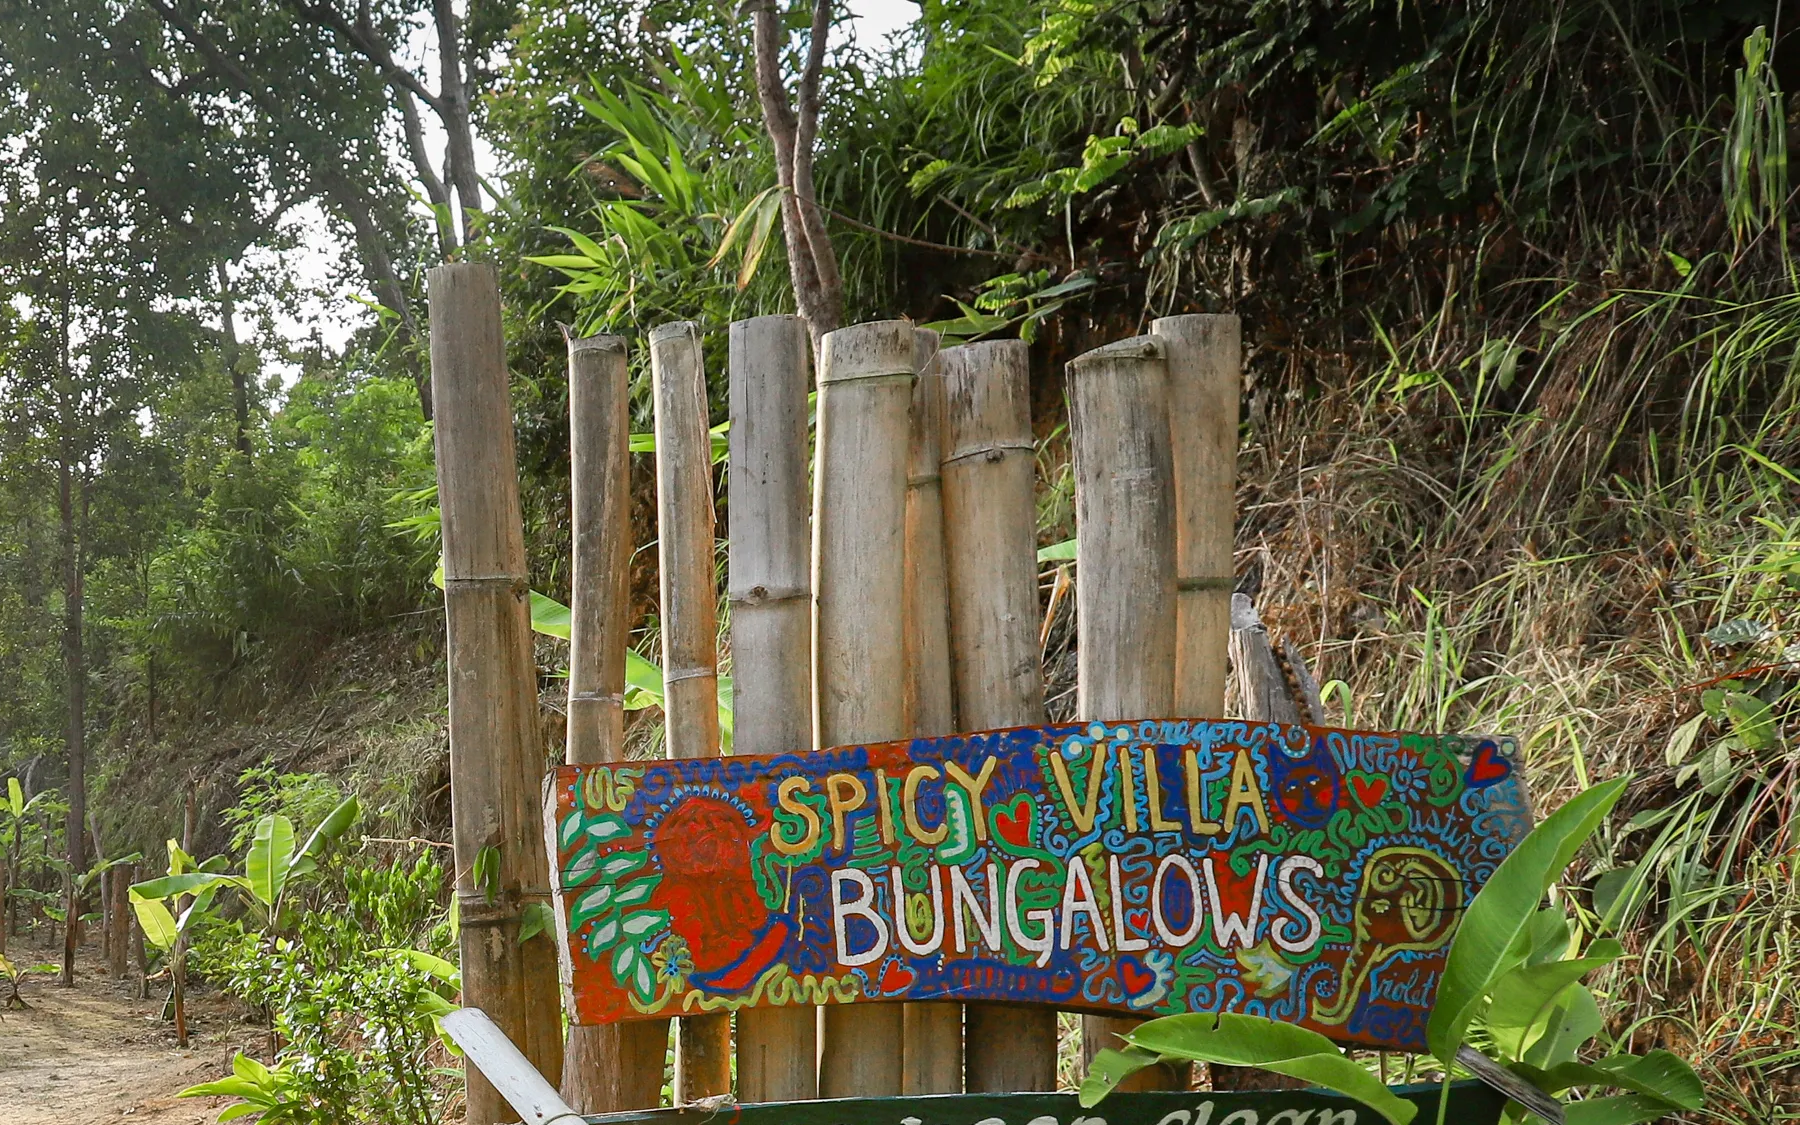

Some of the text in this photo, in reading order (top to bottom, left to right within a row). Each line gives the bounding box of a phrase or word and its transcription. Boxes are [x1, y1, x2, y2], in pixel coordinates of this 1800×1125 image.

[770, 743, 1270, 855] SPICY VILLA
[831, 853, 1324, 968] BUNGALOWS
